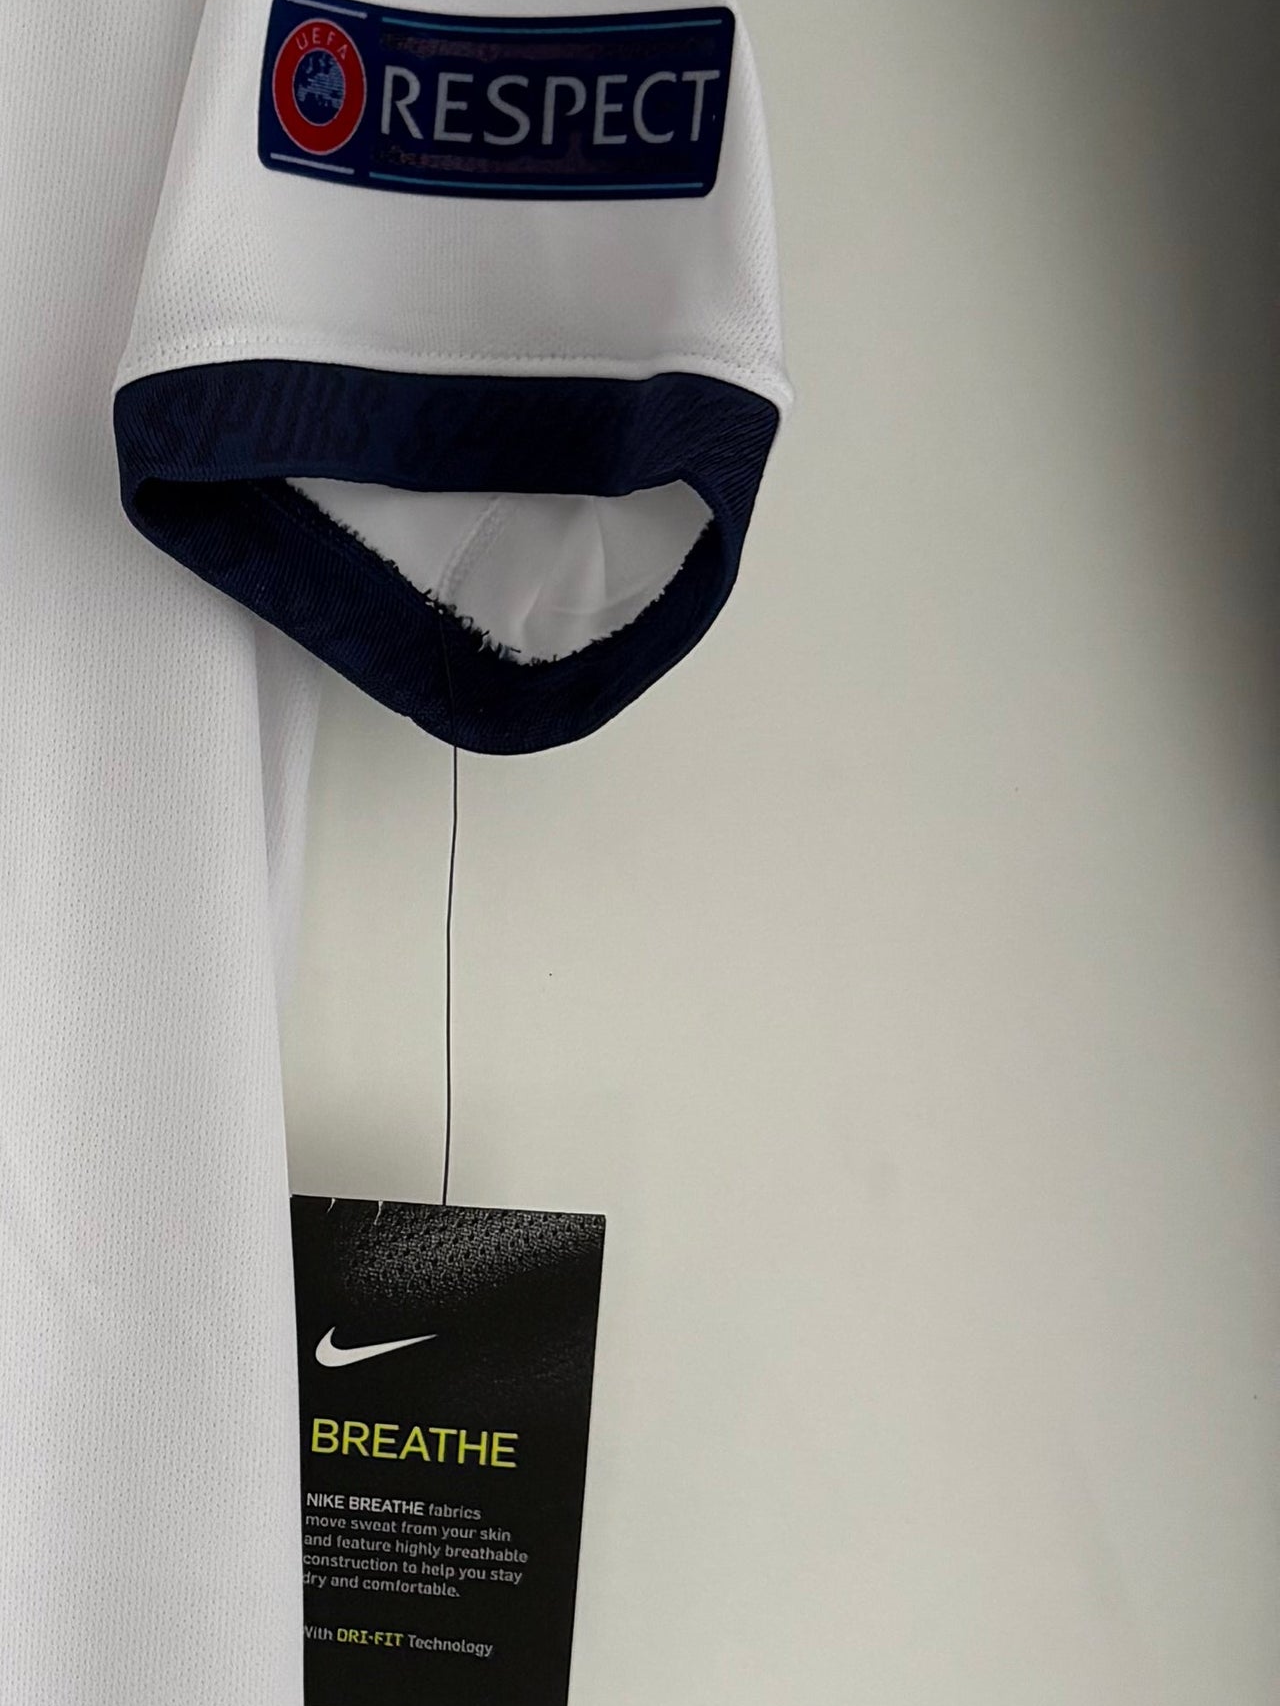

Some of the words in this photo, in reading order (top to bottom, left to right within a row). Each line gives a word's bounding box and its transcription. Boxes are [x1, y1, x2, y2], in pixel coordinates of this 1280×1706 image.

[295, 27, 349, 61] UEFA
[380, 65, 721, 146] RESPECT
[311, 1418, 519, 1468] BREATHE
[306, 1493, 345, 1509] NIKE
[349, 1496, 425, 1516] BREATHE
[428, 1503, 482, 1521] fabrics
[305, 1515, 346, 1529] move
[350, 1518, 398, 1533] sweat
[401, 1520, 437, 1536] from
[441, 1526, 477, 1541] your
[479, 1527, 511, 1542] skin
[304, 1534, 332, 1547] and
[336, 1535, 391, 1552] feature
[395, 1540, 441, 1559] highly
[444, 1544, 529, 1563] breathable
[303, 1553, 398, 1572] construction
[403, 1559, 417, 1574] to
[421, 1561, 455, 1579] help
[458, 1567, 486, 1581] you
[490, 1568, 523, 1585] stay
[303, 1571, 327, 1588] dry
[330, 1574, 359, 1589] and
[362, 1578, 461, 1597] comfortable.
[337, 1628, 404, 1647] DRI-FIT
[408, 1634, 493, 1657] Technology
